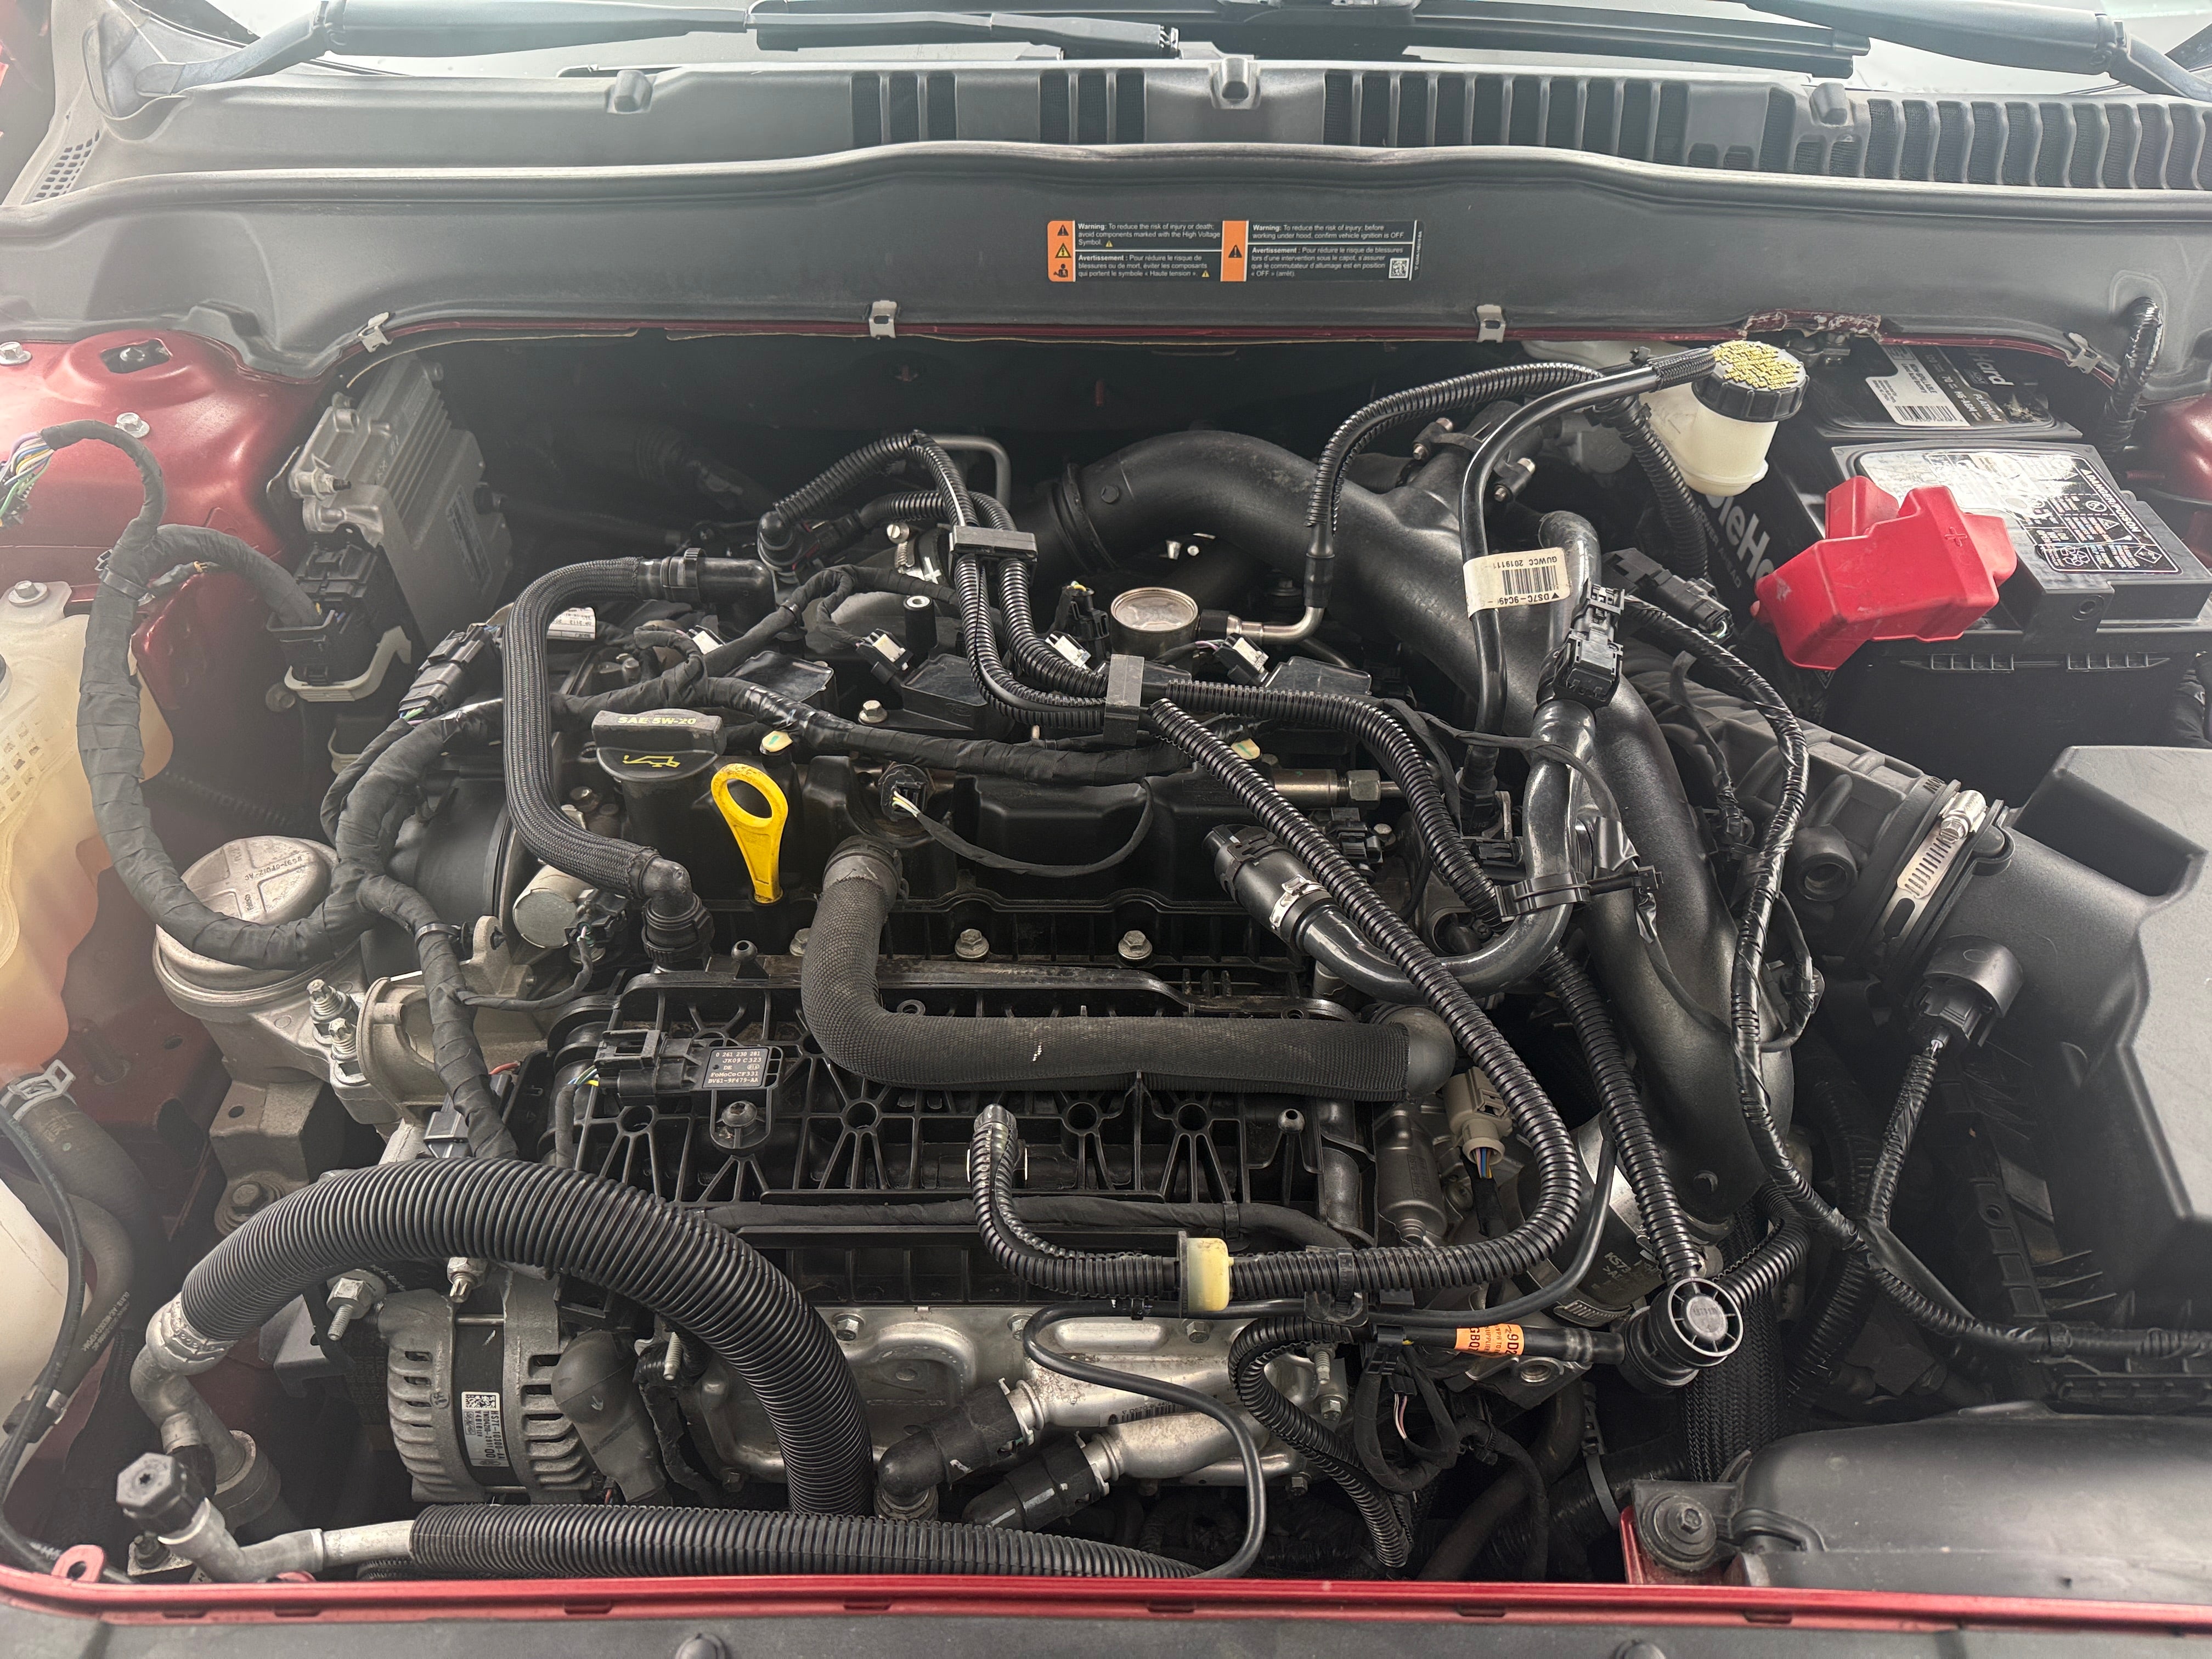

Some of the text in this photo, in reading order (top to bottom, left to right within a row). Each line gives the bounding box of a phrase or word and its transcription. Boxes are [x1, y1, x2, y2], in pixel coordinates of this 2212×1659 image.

[1973, 393, 2002, 421] PLATINUM
[2085, 475, 2142, 531] DANGER/POISON
[1529, 556, 1557, 566] GUWCC
